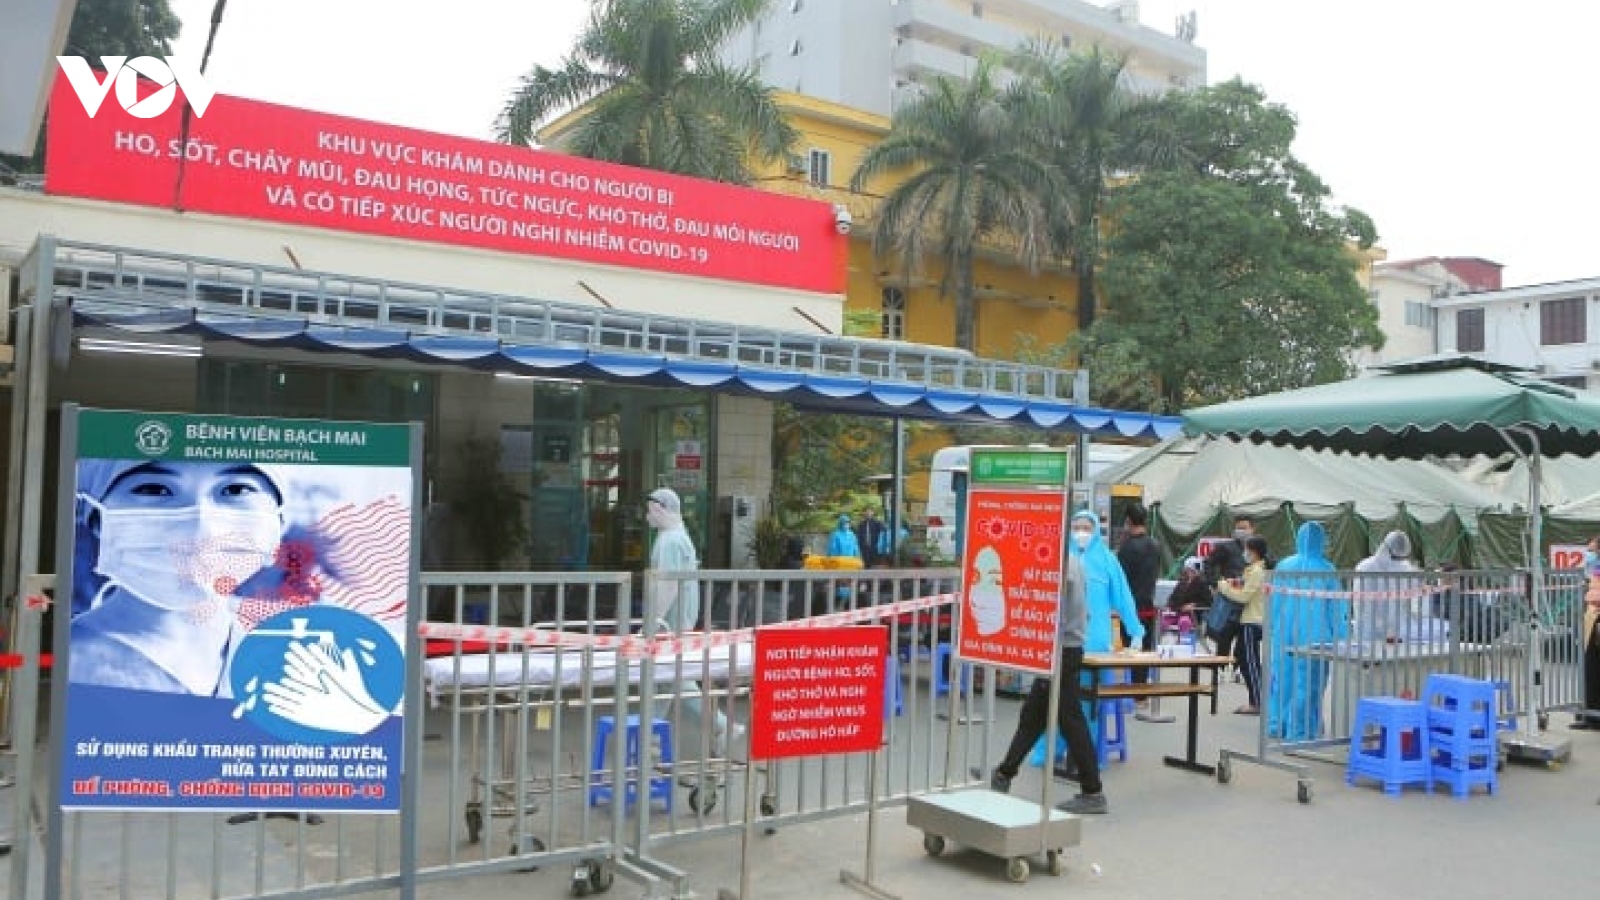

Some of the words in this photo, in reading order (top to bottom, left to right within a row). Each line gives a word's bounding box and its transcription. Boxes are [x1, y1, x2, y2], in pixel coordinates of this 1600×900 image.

[319, 131, 365, 155] KHU
[371, 140, 417, 166] VỰC
[422, 150, 483, 174] KHÁM
[488, 159, 545, 184] DÀNH
[550, 171, 589, 191] CHO
[594, 179, 652, 201] NGƯỜI
[657, 189, 673, 207] BỊ
[115, 131, 160, 157] HO,
[168, 135, 221, 166] SỐT,
[228, 148, 292, 174] CHẢY
[298, 160, 347, 185] MŨI,
[354, 169, 400, 190] ĐAU
[407, 176, 473, 203] HỌNG,
[481, 187, 519, 208] TỨC
[524, 195, 582, 219] NGỰC,
[588, 204, 626, 224] KHÓ
[632, 211, 670, 233] THỞ,
[675, 218, 710, 237] ĐAU
[266, 185, 296, 207] VÀ
[303, 191, 334, 212] CÓ
[340, 196, 385, 219] TIẾP
[391, 204, 434, 226] XÚC
[439, 211, 508, 235] NGƯỜI
[512, 222, 560, 242] NGHI
[564, 227, 624, 252] NHIỄM
[628, 238, 708, 263] COVID-19
[186, 423, 236, 443] BỆNH
[239, 424, 281, 445] VIỆN
[284, 428, 330, 448] BẠCH
[335, 431, 366, 446] MAI
[184, 446, 223, 459] BACH
[226, 447, 252, 460] MAI
[254, 448, 319, 462] HOSPITAL
[1555, 551, 1583, 570] 02
[76, 737, 101, 757] SỬ
[103, 743, 149, 760] DỤNG
[153, 738, 197, 757] KHẨU
[202, 744, 256, 758] TRANG
[261, 742, 324, 759] THƯỜNG
[221, 758, 255, 777] RỬA
[260, 764, 290, 777] TAY
[343, 763, 388, 779] CÁCH
